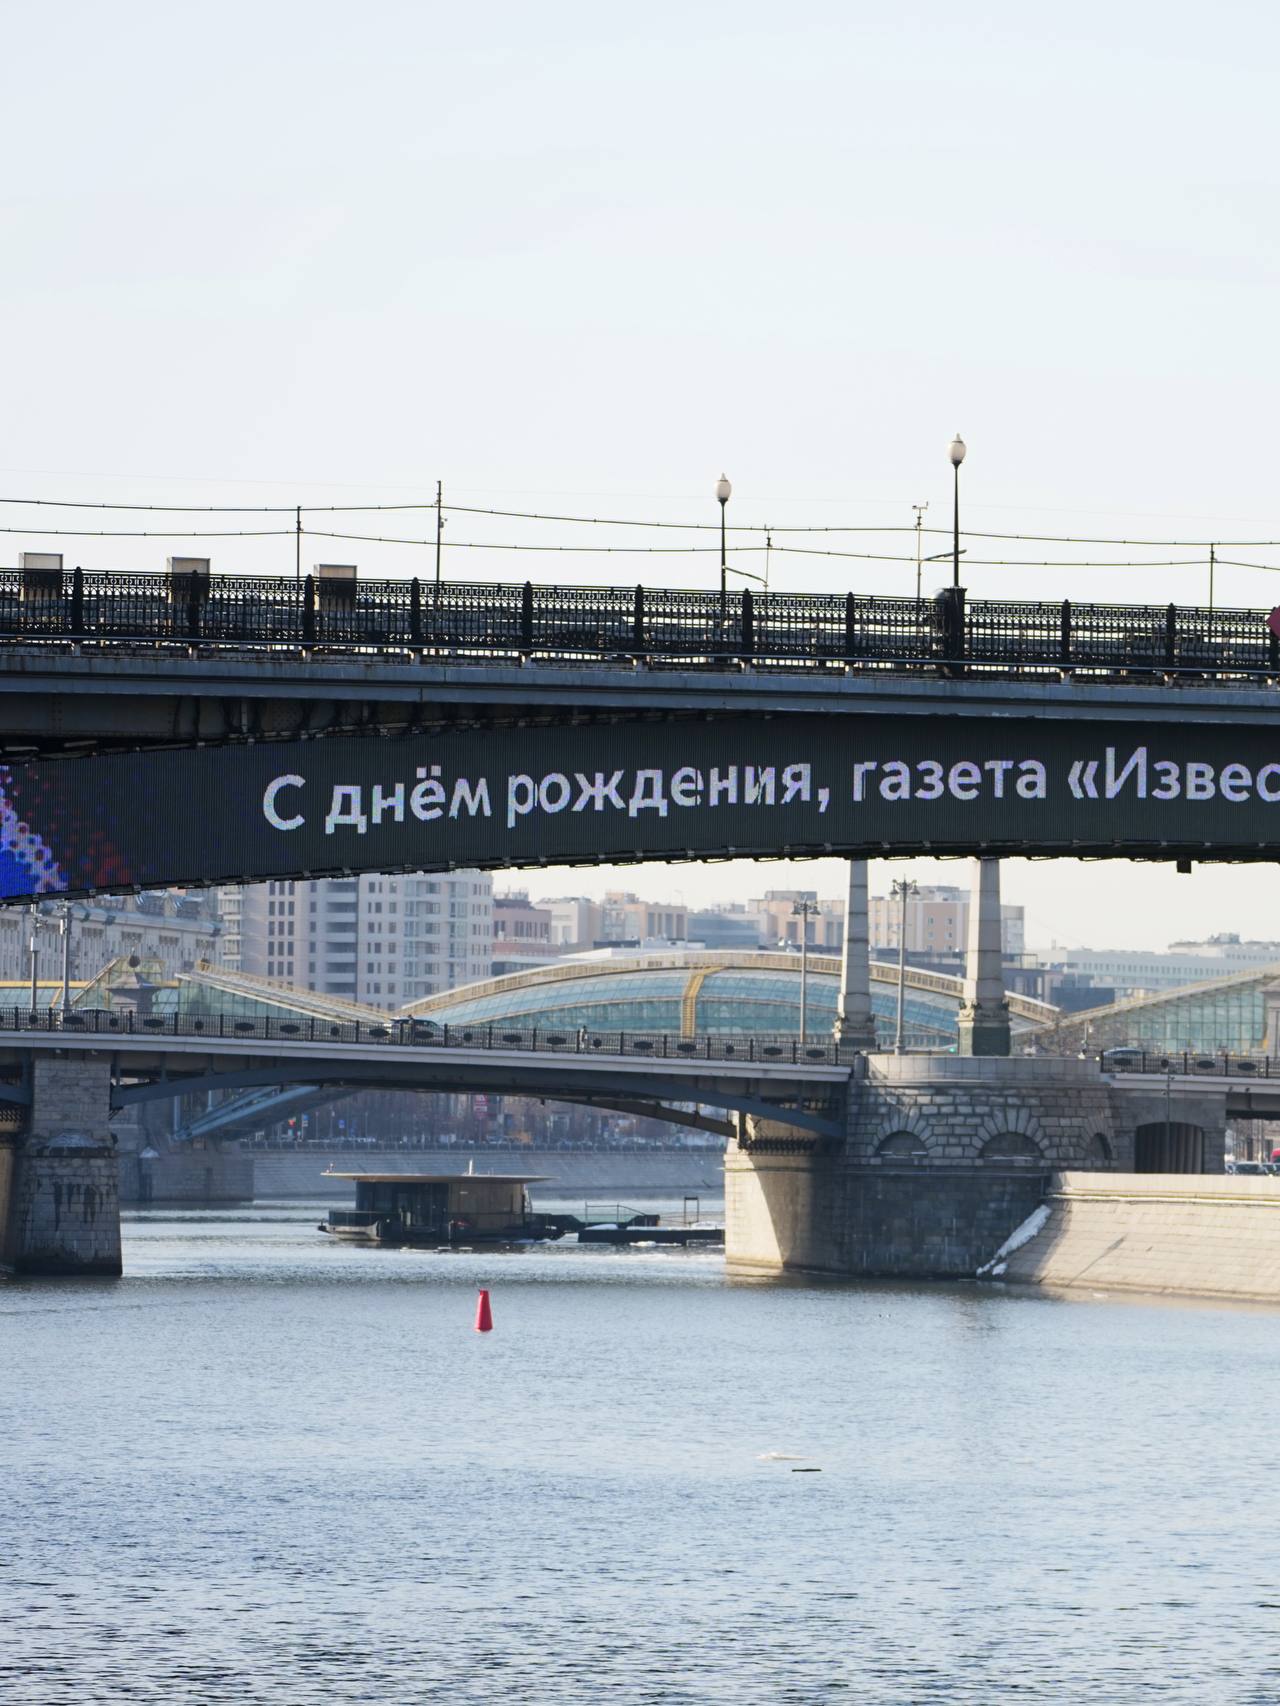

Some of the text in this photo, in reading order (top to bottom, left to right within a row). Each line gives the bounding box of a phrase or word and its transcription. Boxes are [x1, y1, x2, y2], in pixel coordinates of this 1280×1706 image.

[263, 774, 306, 831] С
[325, 765, 492, 835] днём
[506, 763, 831, 829] рождения,
[853, 759, 1048, 803] газета
